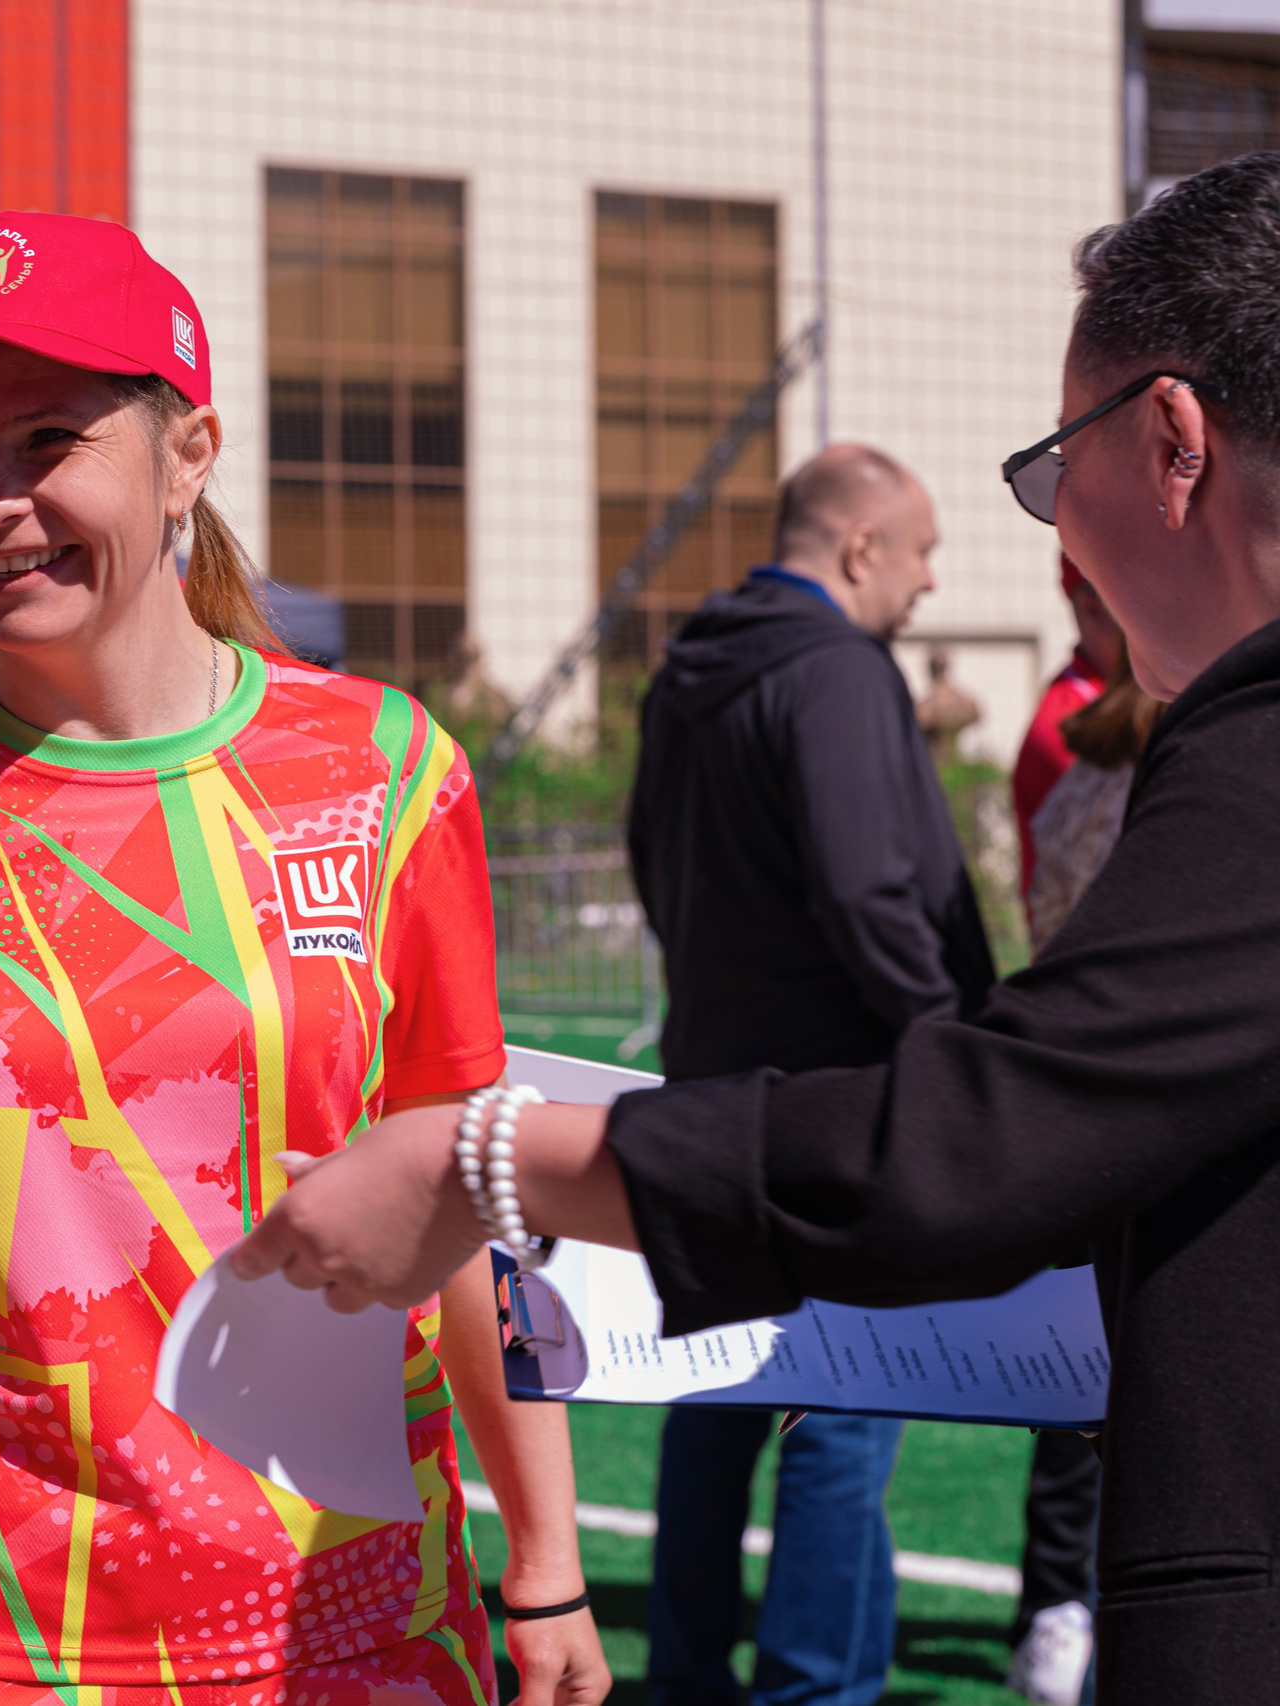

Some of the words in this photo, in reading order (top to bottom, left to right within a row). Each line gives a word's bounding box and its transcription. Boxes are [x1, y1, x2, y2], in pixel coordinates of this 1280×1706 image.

[22, 249, 36, 257] Я
[0, 262, 35, 295] СЕМЬЯ
[293, 932, 364, 957] ЛУКОЙЛ
